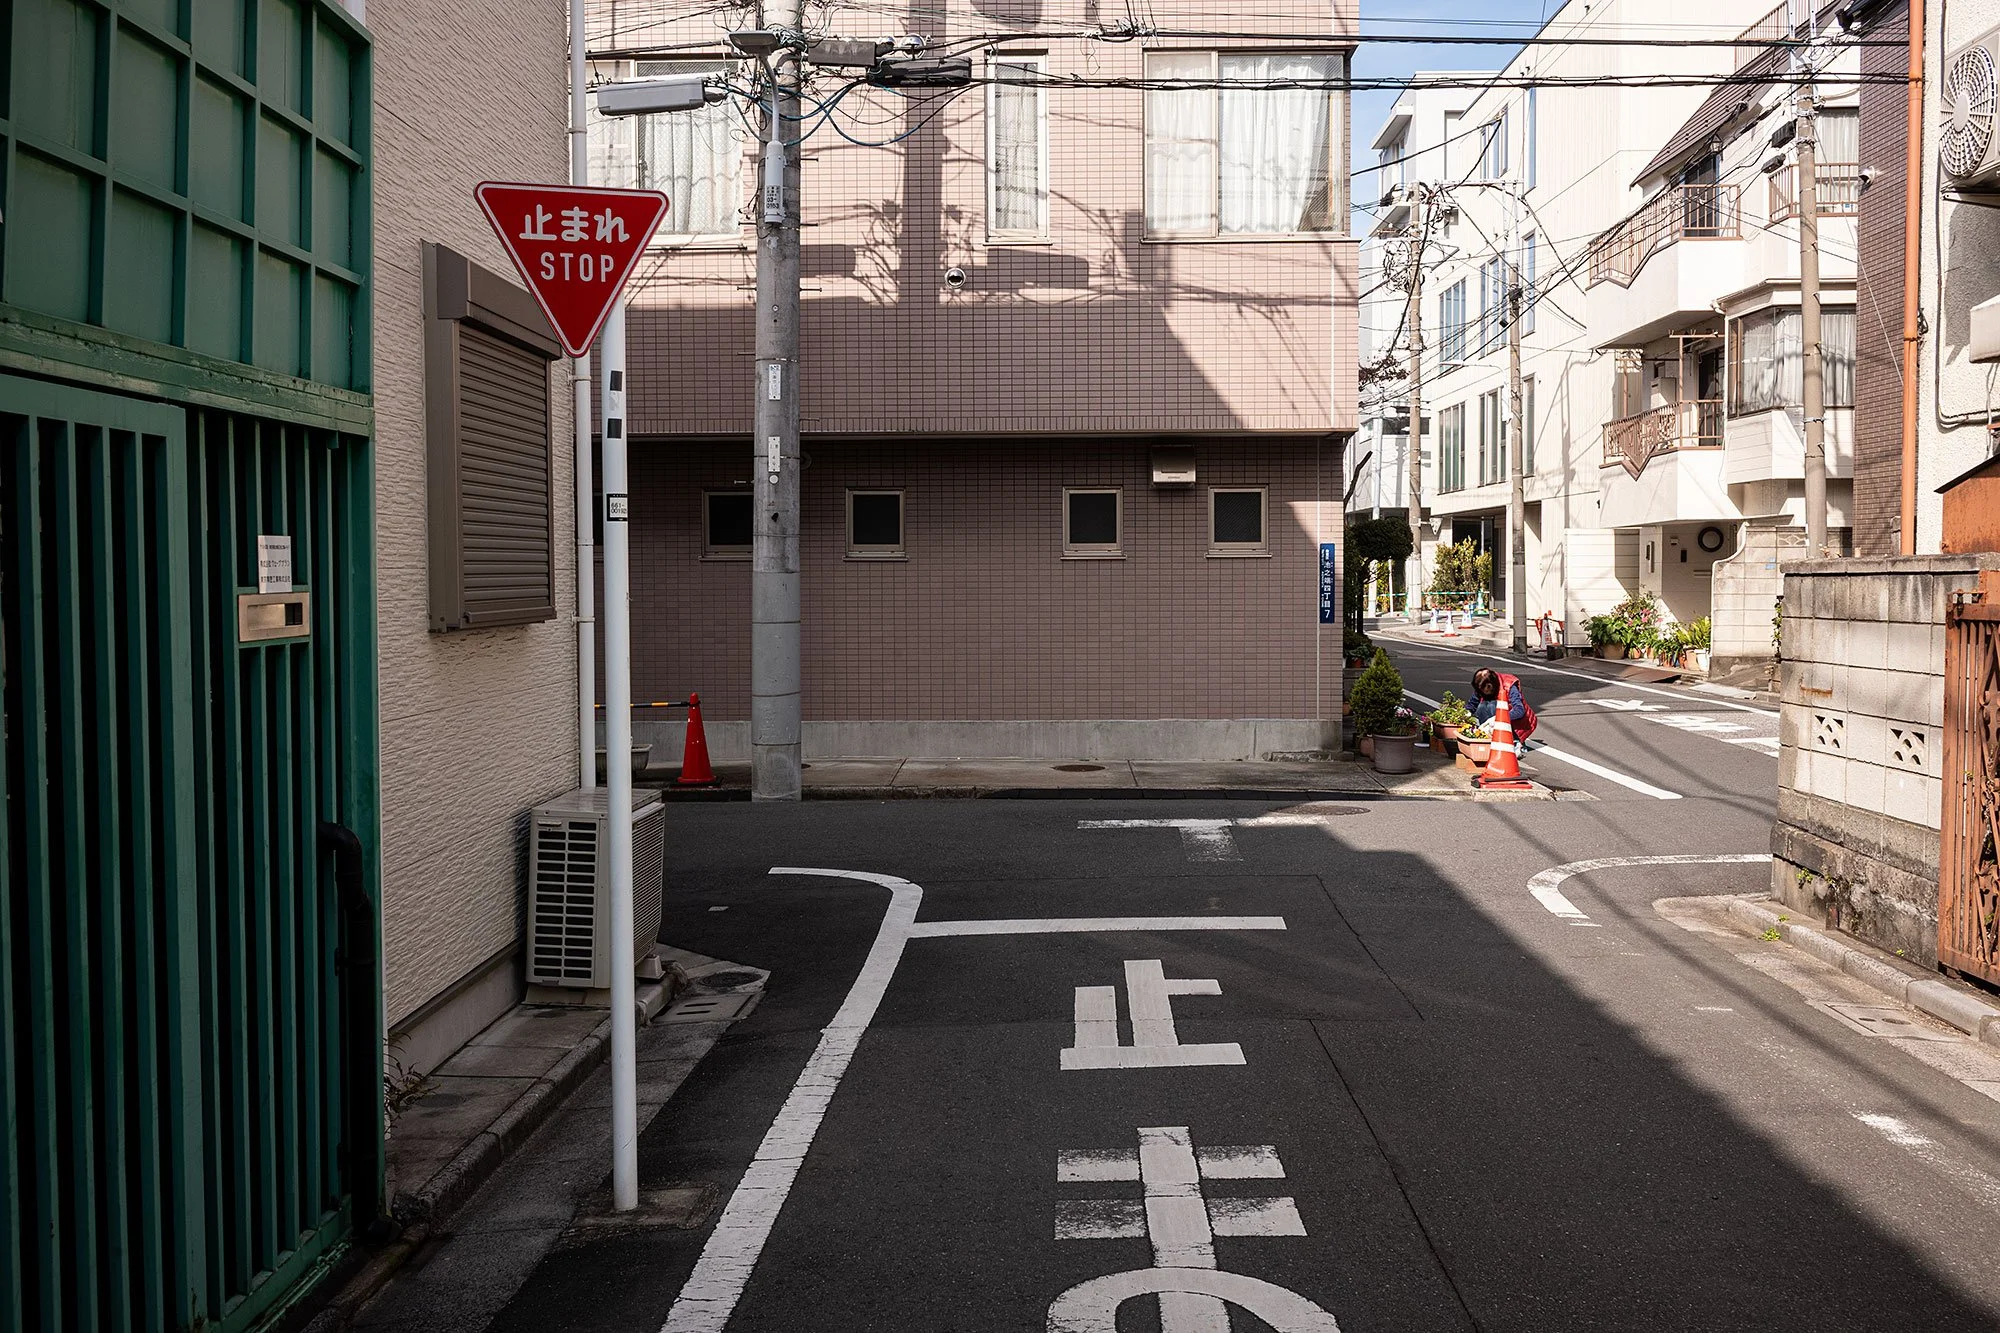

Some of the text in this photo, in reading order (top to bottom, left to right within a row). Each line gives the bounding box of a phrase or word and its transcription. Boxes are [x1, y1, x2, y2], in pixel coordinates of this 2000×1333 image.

[519, 204, 631, 244] 止まれ
[540, 252, 615, 283] STOP
